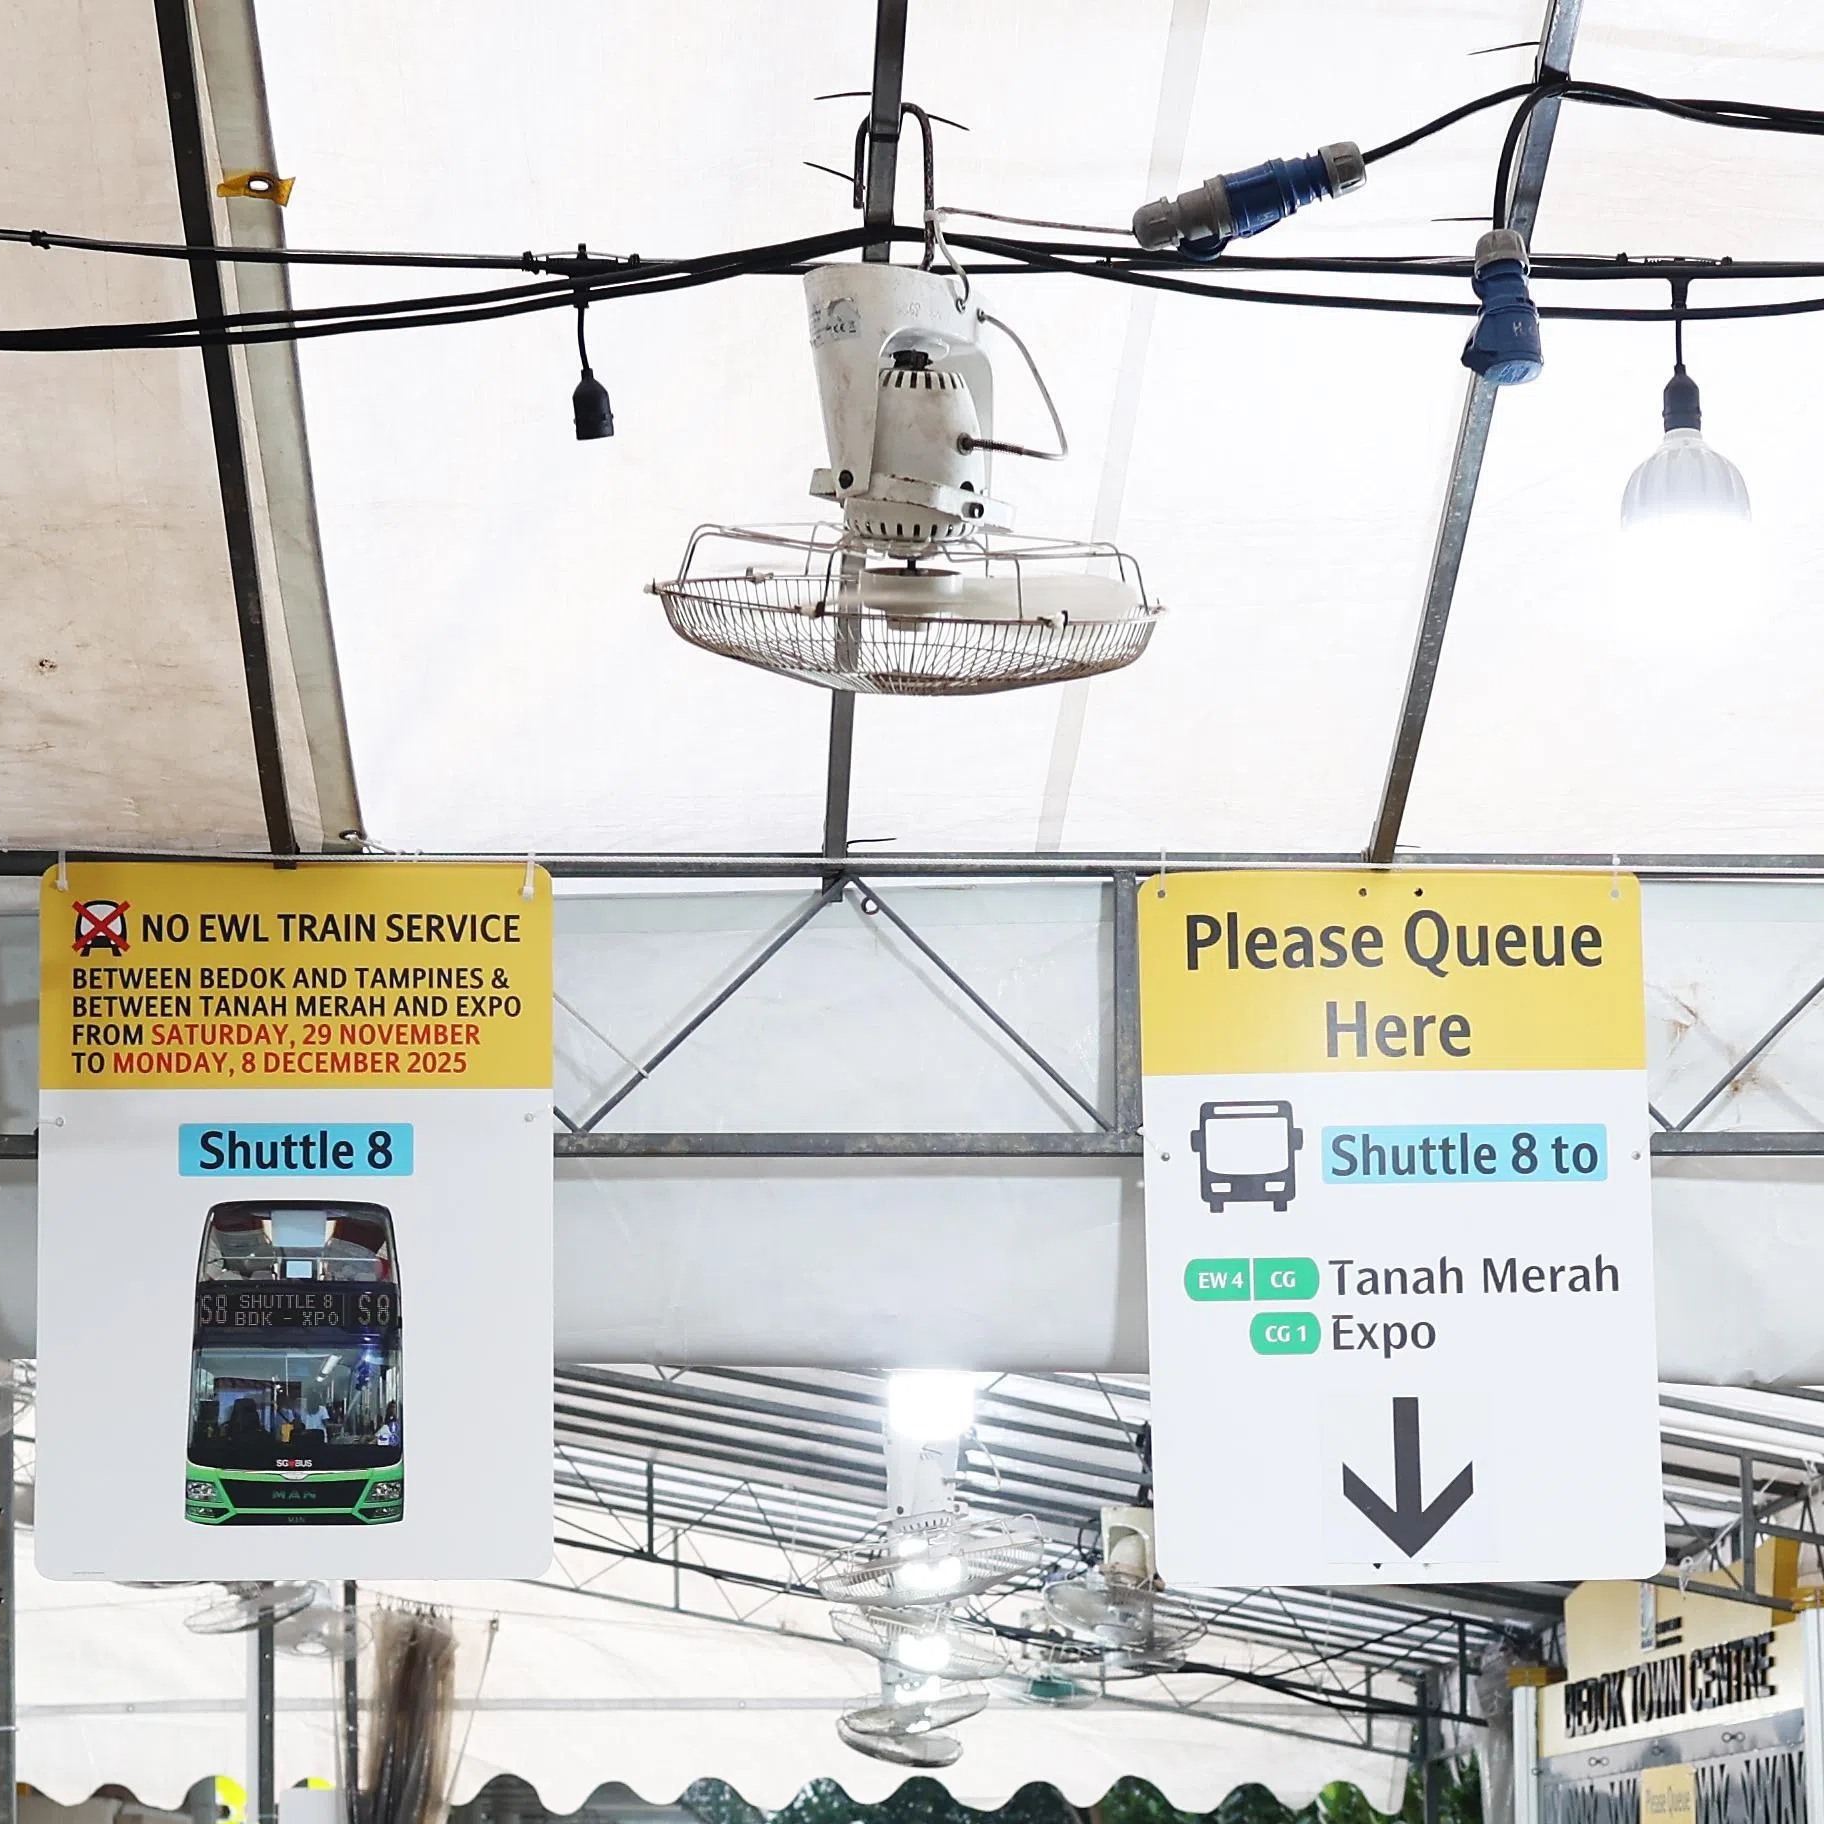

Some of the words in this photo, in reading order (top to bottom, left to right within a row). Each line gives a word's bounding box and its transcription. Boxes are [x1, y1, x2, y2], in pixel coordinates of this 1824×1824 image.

[1186, 911, 1384, 971] Please
[1404, 909, 1603, 978] Queue
[1325, 1000, 1471, 1058] Here
[199, 1130, 354, 1170] Shuttle
[367, 1130, 393, 1170] 8
[1331, 1132, 1497, 1177] Shuttle
[1511, 1132, 1538, 1175] 8
[1550, 1135, 1598, 1175] to
[1198, 1271, 1228, 1289] EW
[1231, 1271, 1244, 1289] 4
[1270, 1270, 1296, 1289] CG
[1328, 1255, 1464, 1296] Tanah
[1482, 1253, 1619, 1294] Merah
[239, 1293, 316, 1309] SHUTTLE
[323, 1293, 333, 1309] 8
[1264, 1325, 1291, 1343] CG
[1297, 1325, 1308, 1342] 1
[1331, 1314, 1436, 1359] Expo
[1626, 1654, 1687, 1724] TOWN
